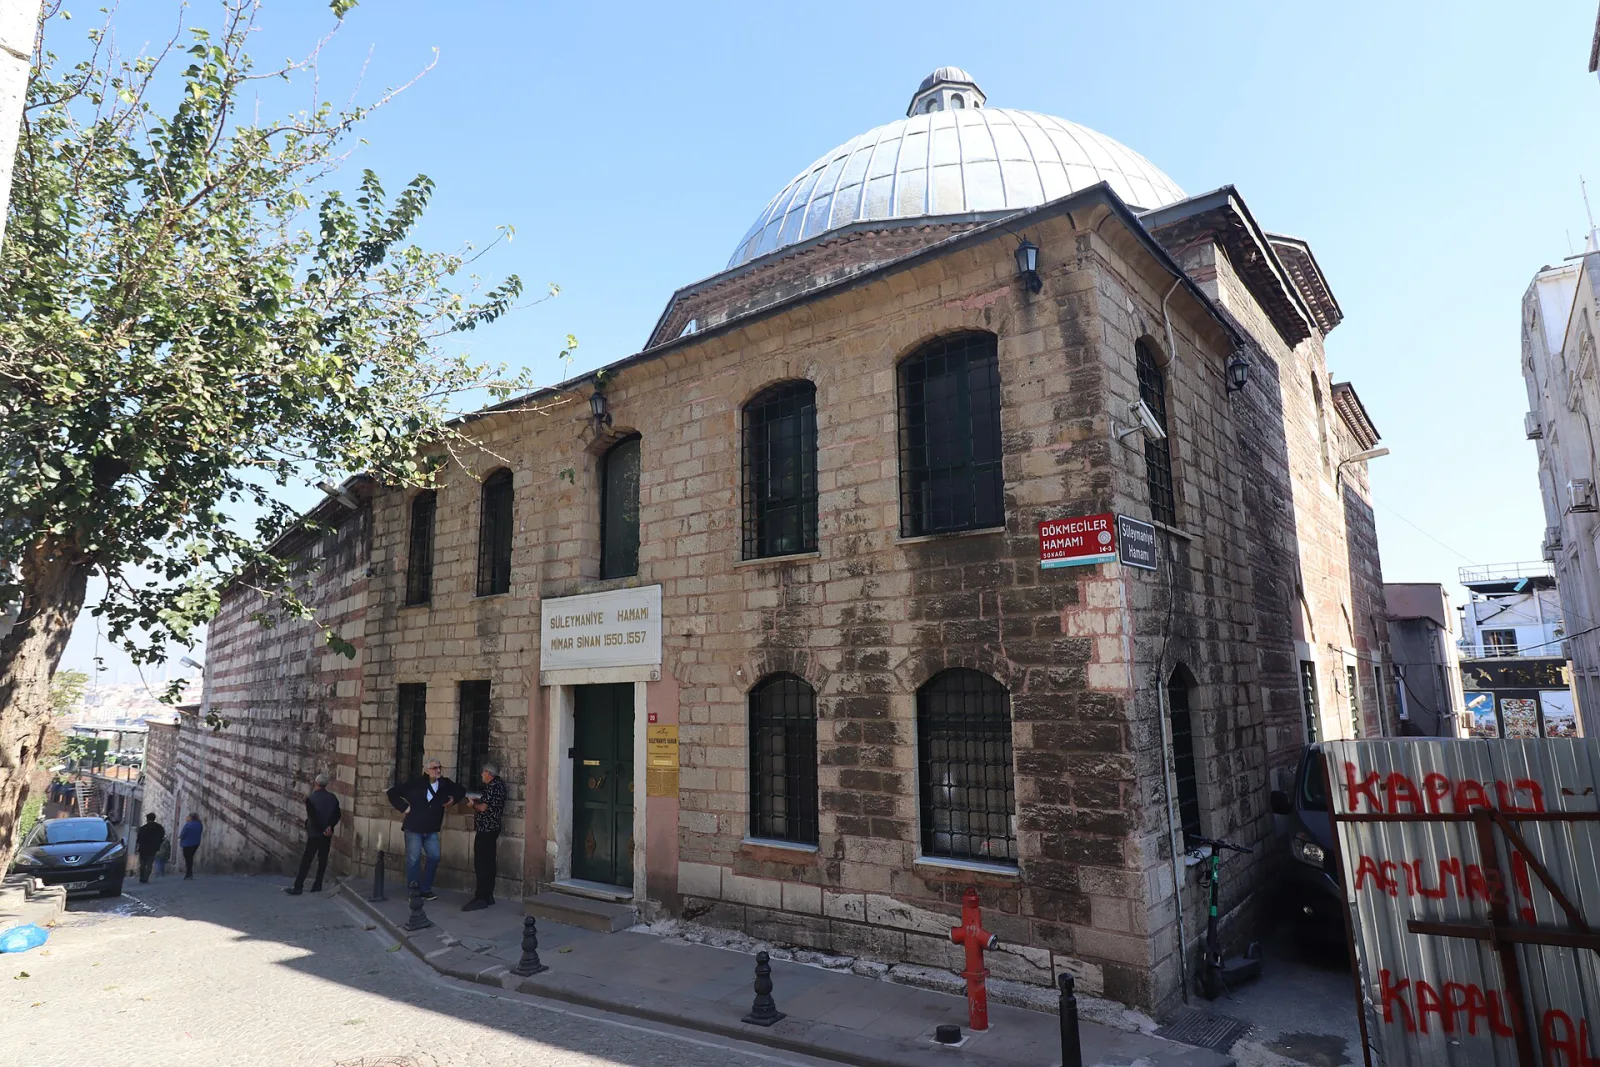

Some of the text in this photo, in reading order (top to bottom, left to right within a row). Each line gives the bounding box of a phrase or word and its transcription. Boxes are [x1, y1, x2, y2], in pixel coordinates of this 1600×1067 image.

[1042, 519, 1107, 537] DÖKMECİLER
[1122, 523, 1154, 545] Süleymaniye
[1043, 536, 1083, 550] HAMAMI
[1128, 544, 1150, 561] Hamamı
[550, 607, 649, 629] SÜLEYMANİYE HAMAMI
[551, 636, 574, 650] MİMAR
[577, 634, 601, 648] SİNAN
